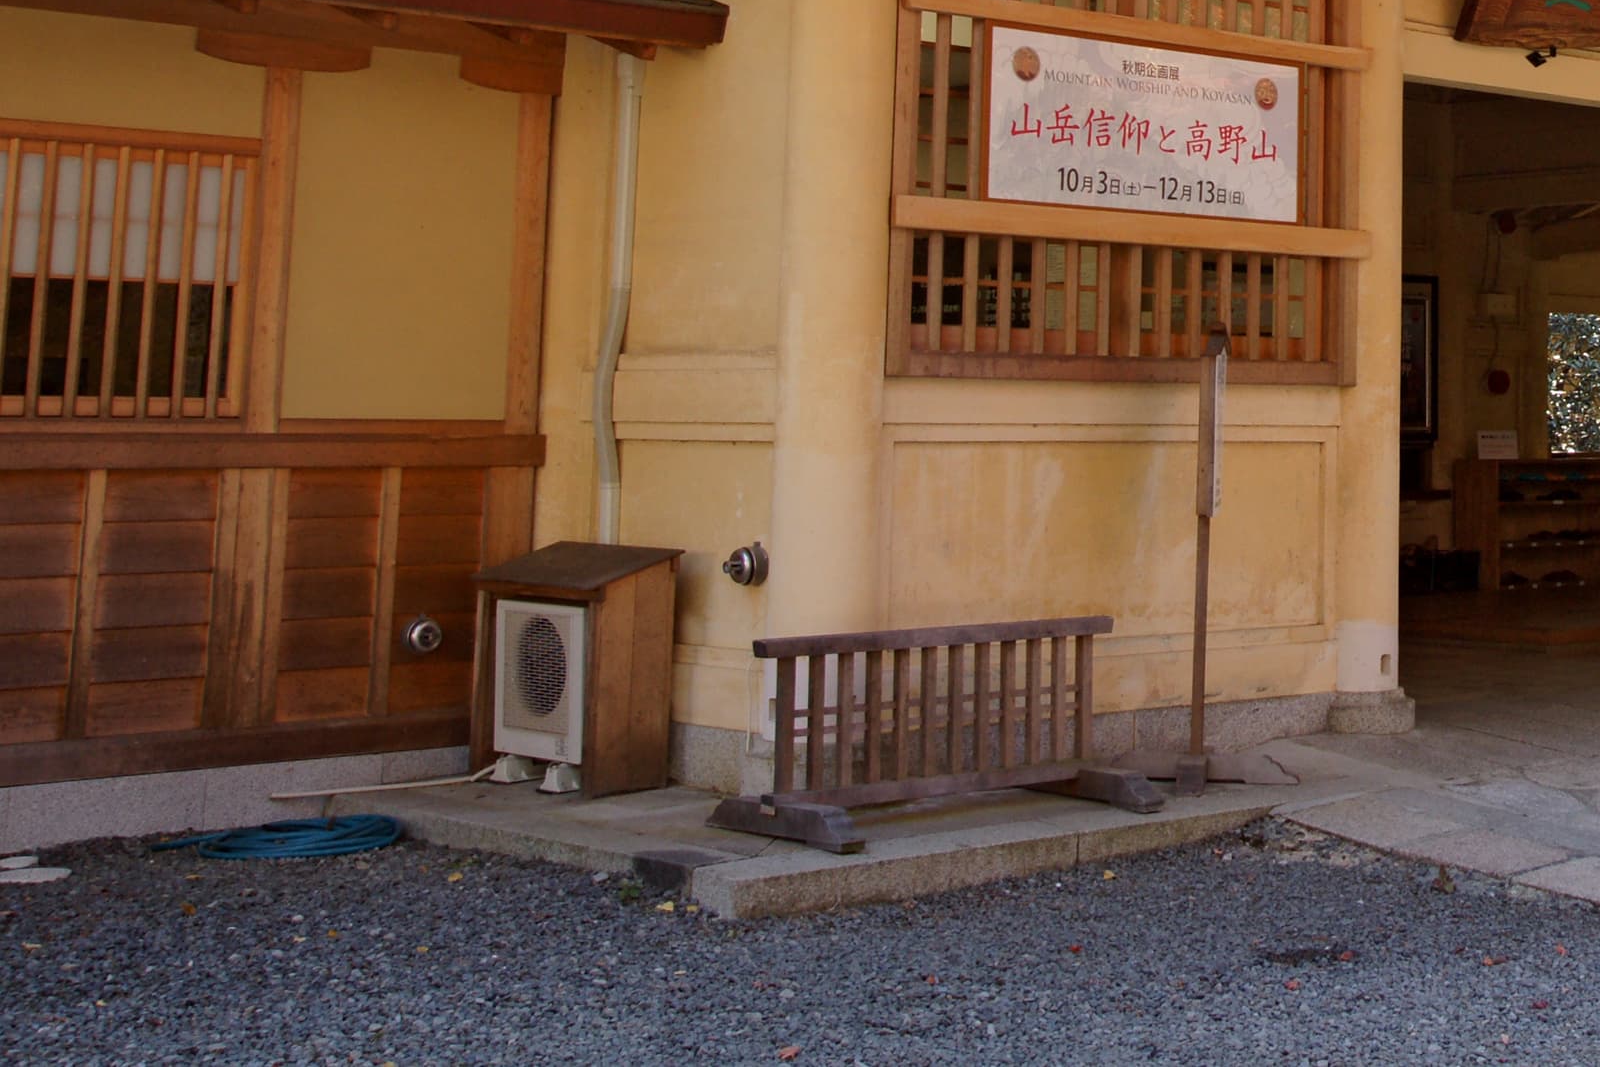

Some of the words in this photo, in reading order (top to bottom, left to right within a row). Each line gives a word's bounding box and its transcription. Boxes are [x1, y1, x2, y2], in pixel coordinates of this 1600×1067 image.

[1043, 69, 1113, 88] MOUNTAIN
[1116, 77, 1171, 95] WORSHIP
[1121, 59, 1180, 81] 秋期企画展
[1011, 102, 1277, 164] 山岳信仰と高野山
